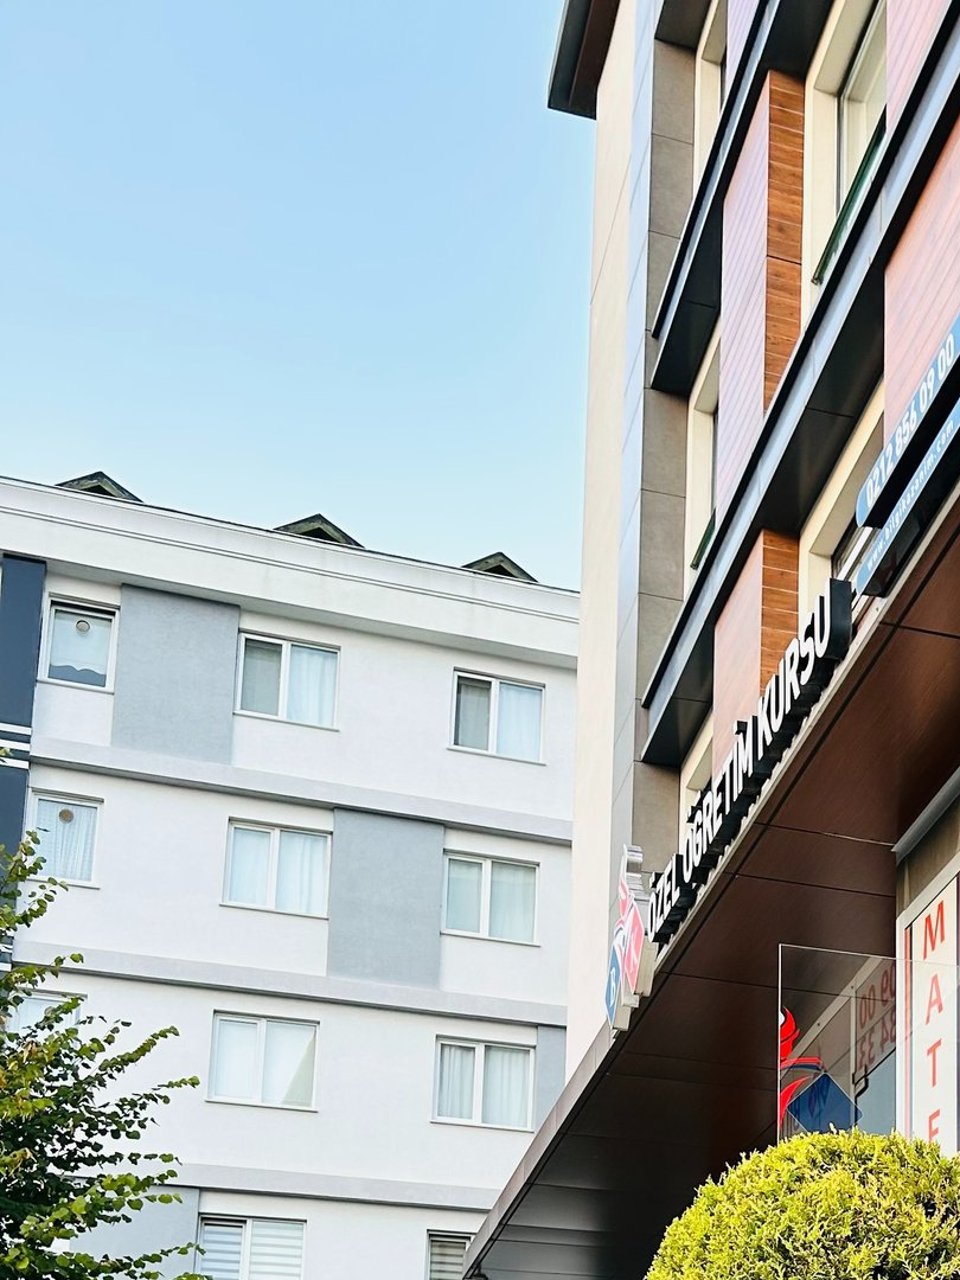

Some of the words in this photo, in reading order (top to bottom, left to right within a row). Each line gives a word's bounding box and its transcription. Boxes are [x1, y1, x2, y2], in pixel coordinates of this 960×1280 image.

[866, 443, 894, 508] 0212
[895, 408, 917, 458] 856
[919, 368, 935, 415] 09
[938, 333, 955, 381] 00
[646, 853, 682, 942] ÖZEL
[757, 593, 832, 760] KURSU
